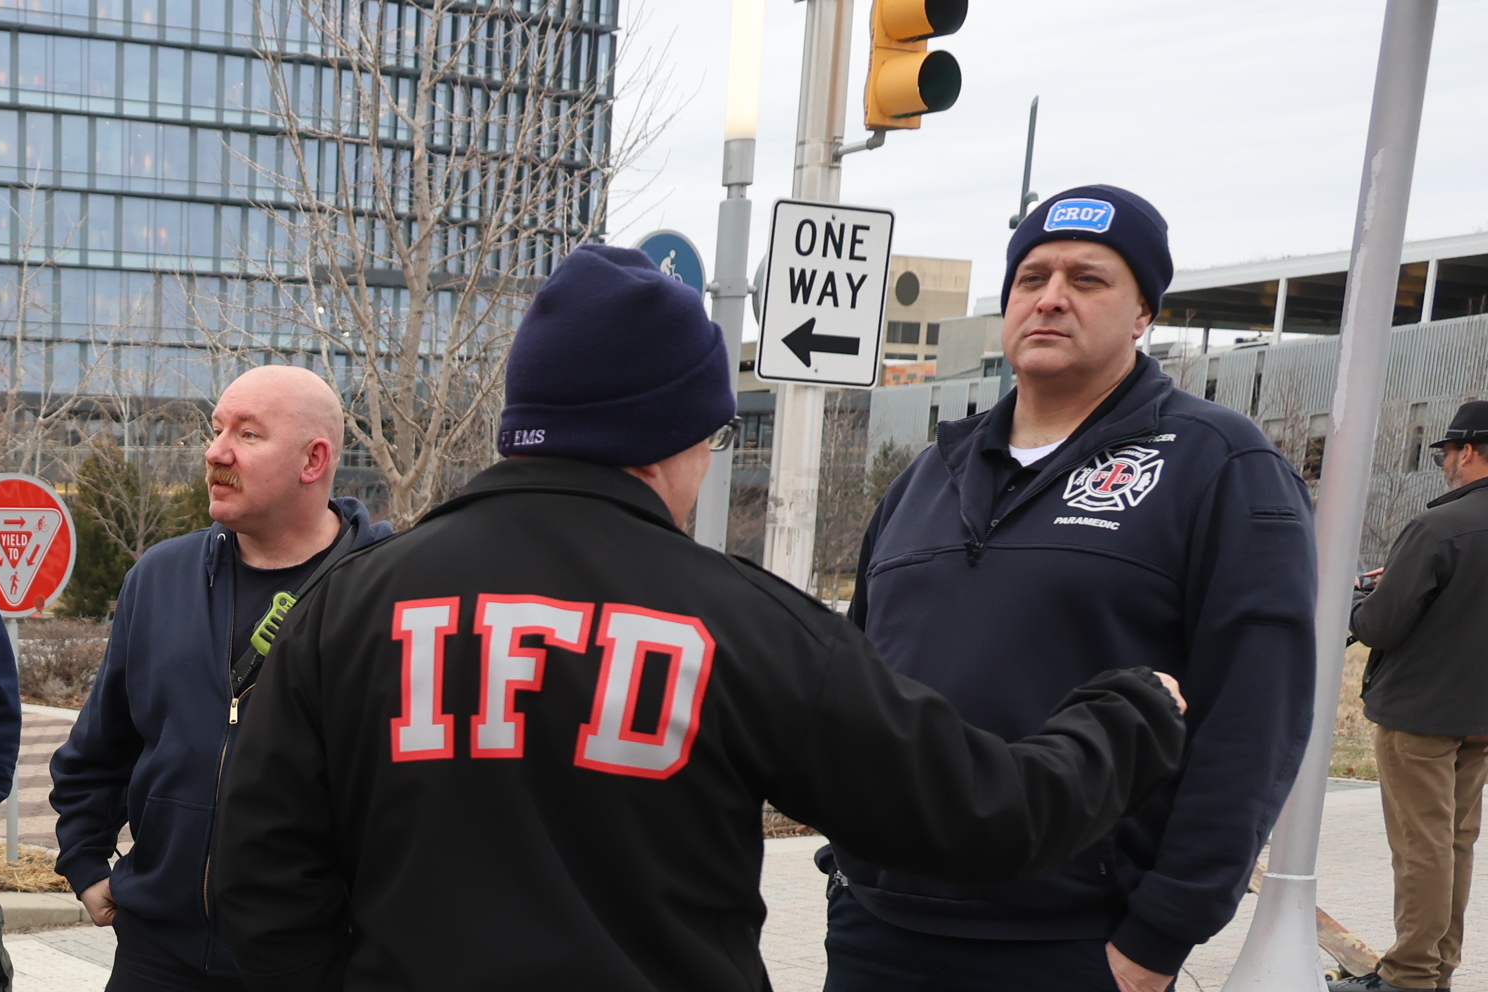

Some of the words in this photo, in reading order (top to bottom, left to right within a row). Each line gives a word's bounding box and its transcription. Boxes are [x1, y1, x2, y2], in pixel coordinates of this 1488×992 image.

[1053, 207, 1107, 222] CR07
[794, 218, 870, 262] ONE
[789, 267, 868, 309] WAY
[513, 429, 546, 446] EMS
[1053, 516, 1120, 531] PARAMEDIC
[1, 533, 28, 546] YIELD
[7, 547, 19, 560] TO
[390, 593, 717, 780] IFD
